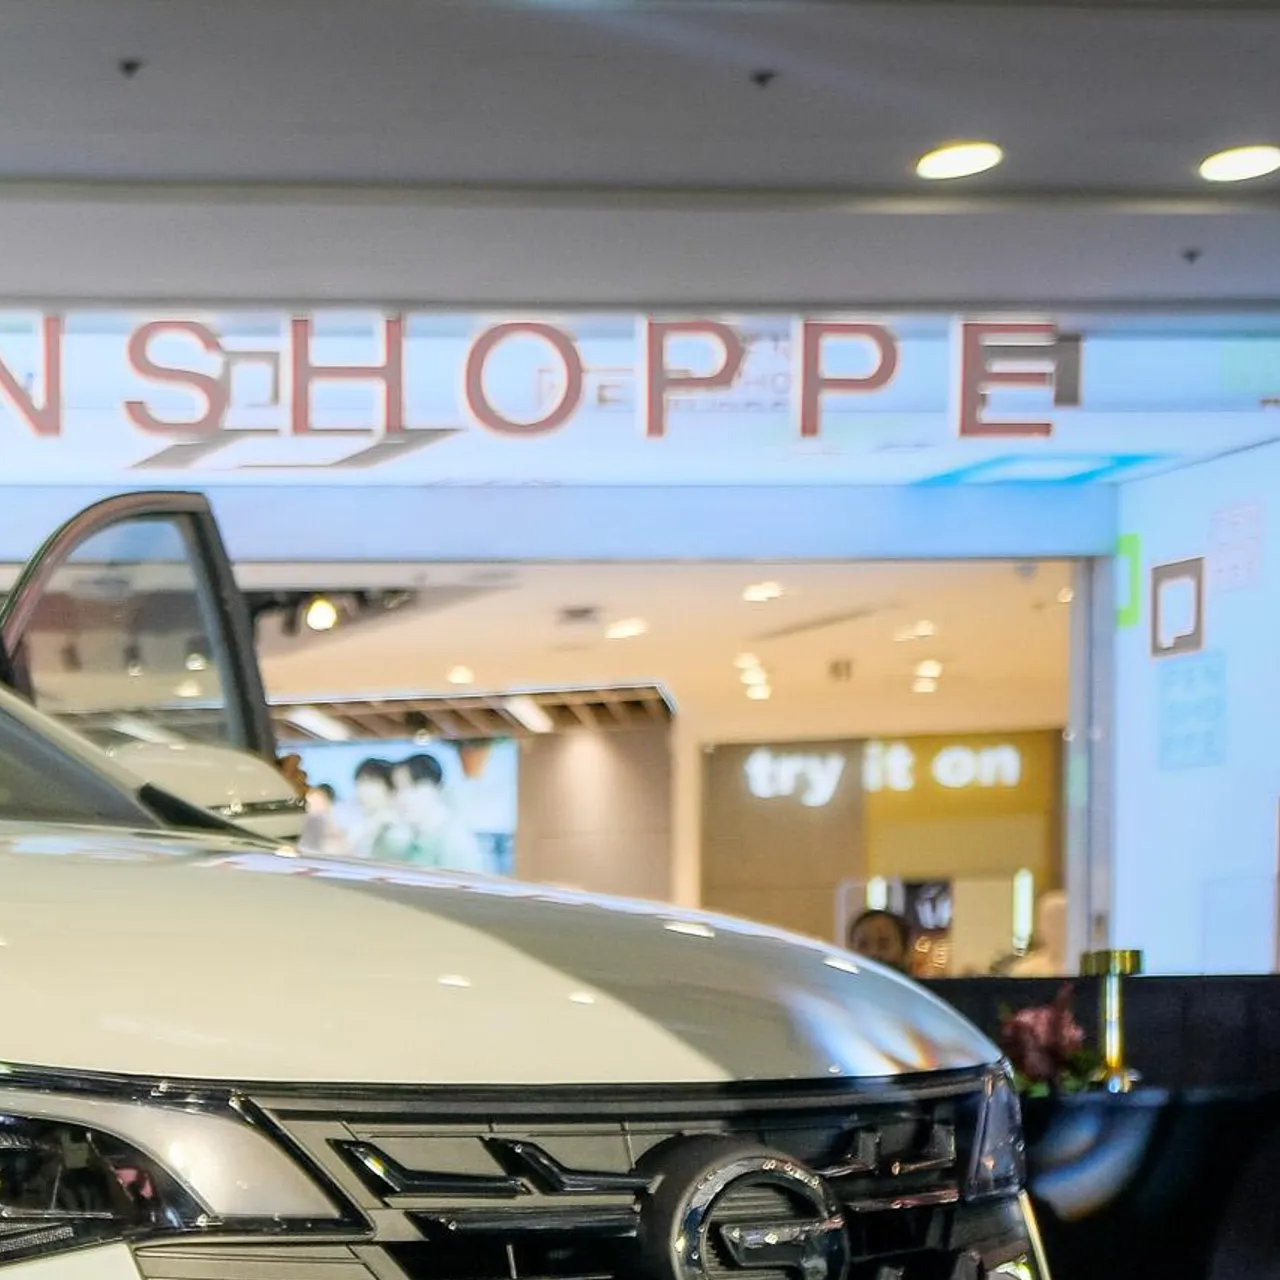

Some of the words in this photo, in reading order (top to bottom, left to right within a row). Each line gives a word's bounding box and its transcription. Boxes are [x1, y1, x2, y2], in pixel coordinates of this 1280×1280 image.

[744, 747, 845, 806] try
[862, 740, 915, 792] it
[931, 744, 1020, 788] on
